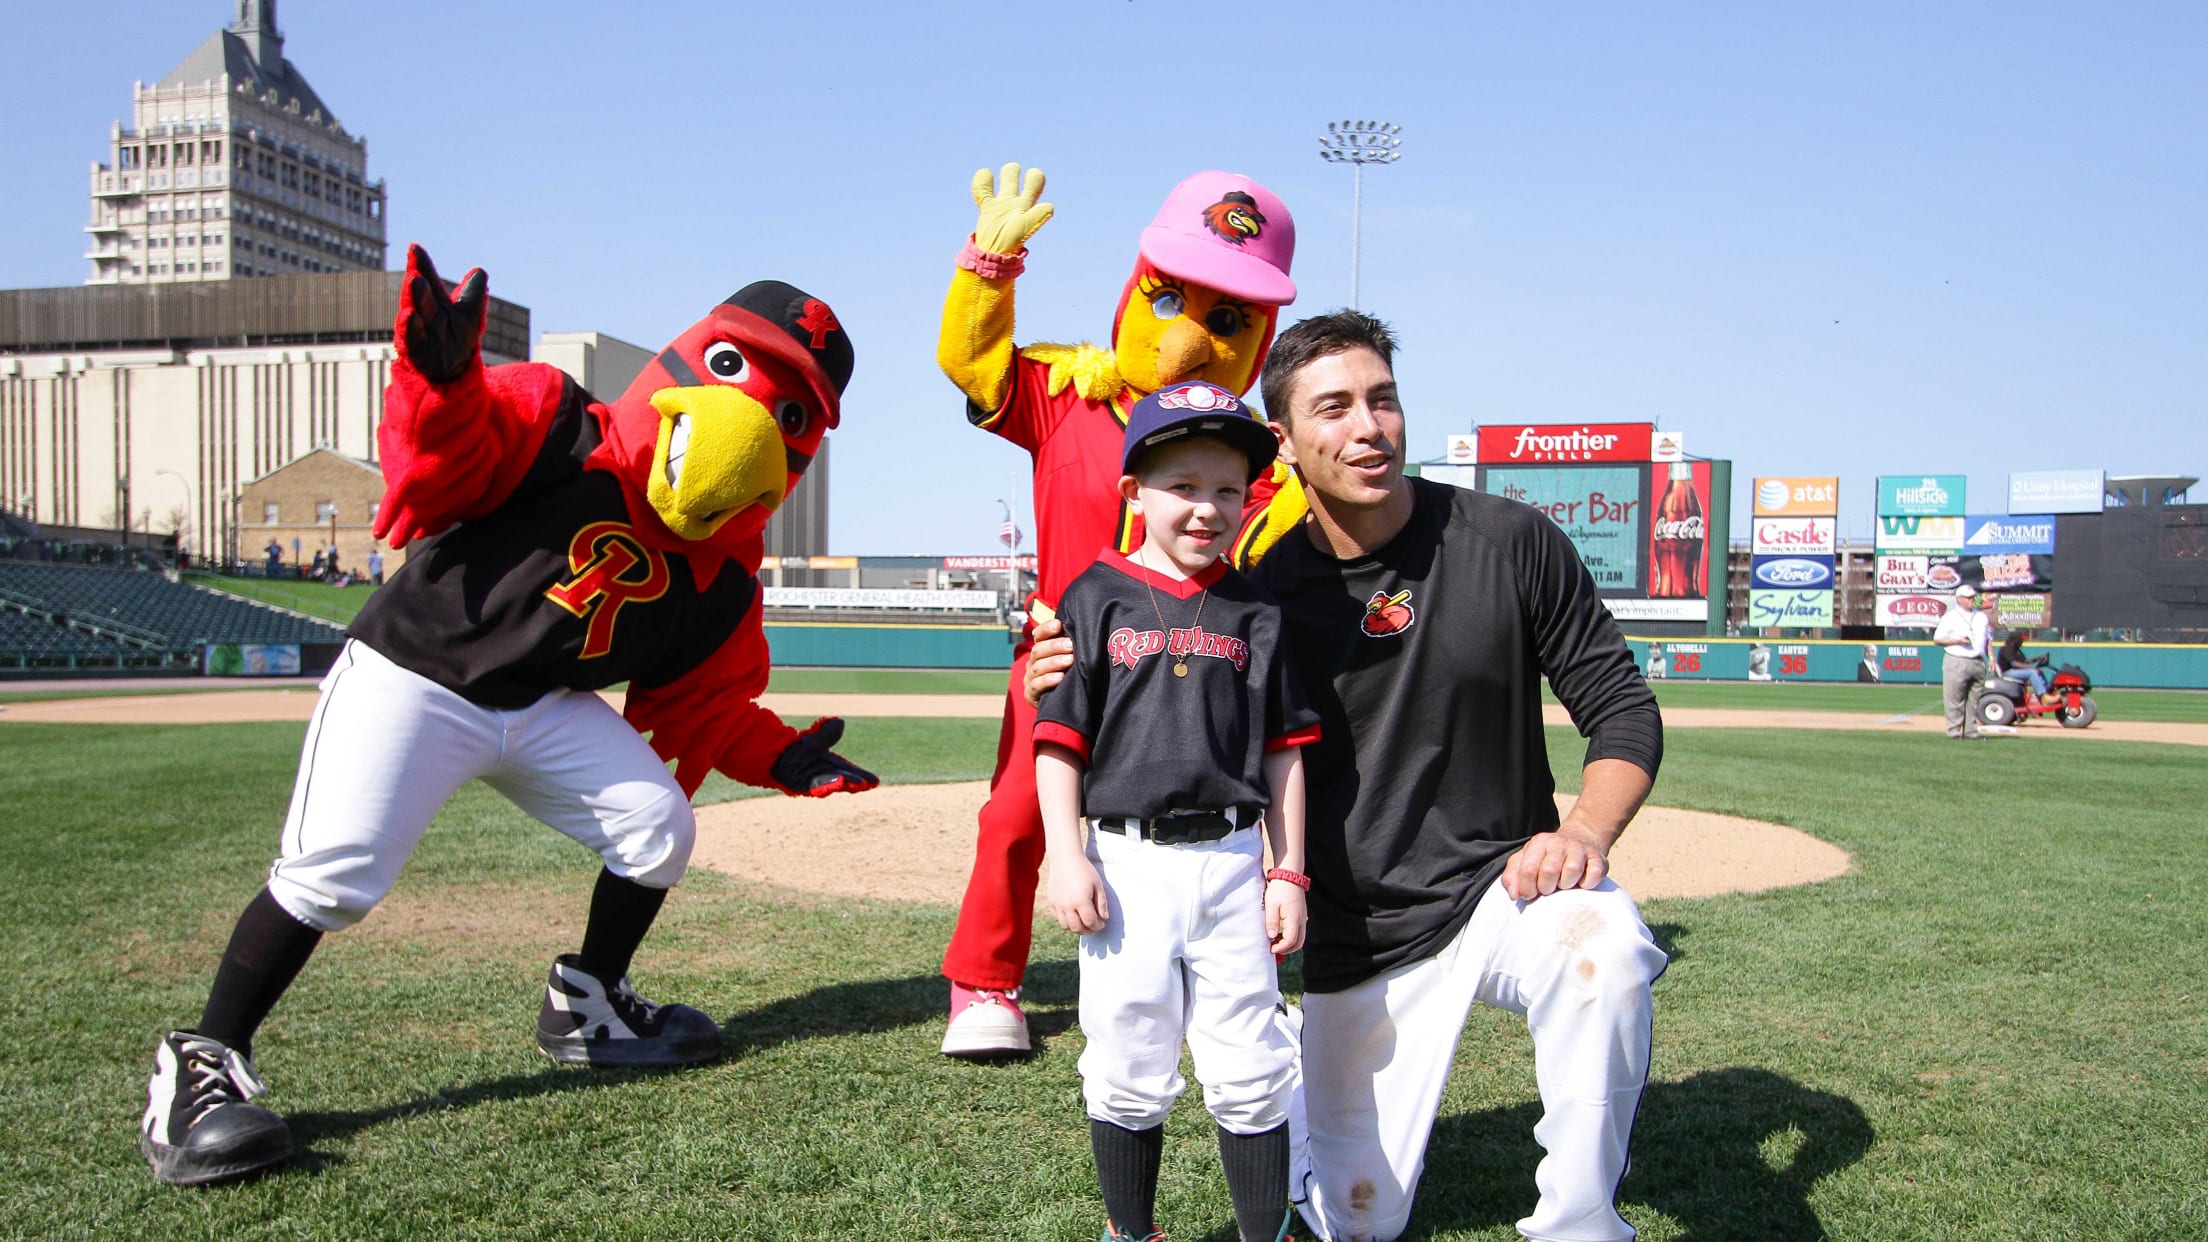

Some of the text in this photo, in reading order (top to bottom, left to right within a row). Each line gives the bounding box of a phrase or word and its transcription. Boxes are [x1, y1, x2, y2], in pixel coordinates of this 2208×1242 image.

[1510, 427, 1619, 459] frontier
[1534, 451, 1592, 461] FIELD
[1503, 484, 1527, 500] the
[1793, 483, 1834, 503] at&t
[1895, 486, 1949, 505] Hillside
[1588, 491, 1639, 525] Bar
[1758, 519, 1829, 545] Castle
[1988, 525, 2052, 540] SUMMIT
[1606, 571, 1623, 582] AM
[1770, 562, 1815, 581] Ford
[544, 521, 671, 660] R
[768, 591, 988, 605] ROCHESTER GENERAL HEALTH SYSTEM
[1753, 593, 1830, 626] Sylvan
[1895, 601, 1940, 614] LEO'S
[1107, 625, 1249, 672] RED WINGS
[1673, 653, 1700, 673] 26
[1779, 654, 1807, 675] 36
